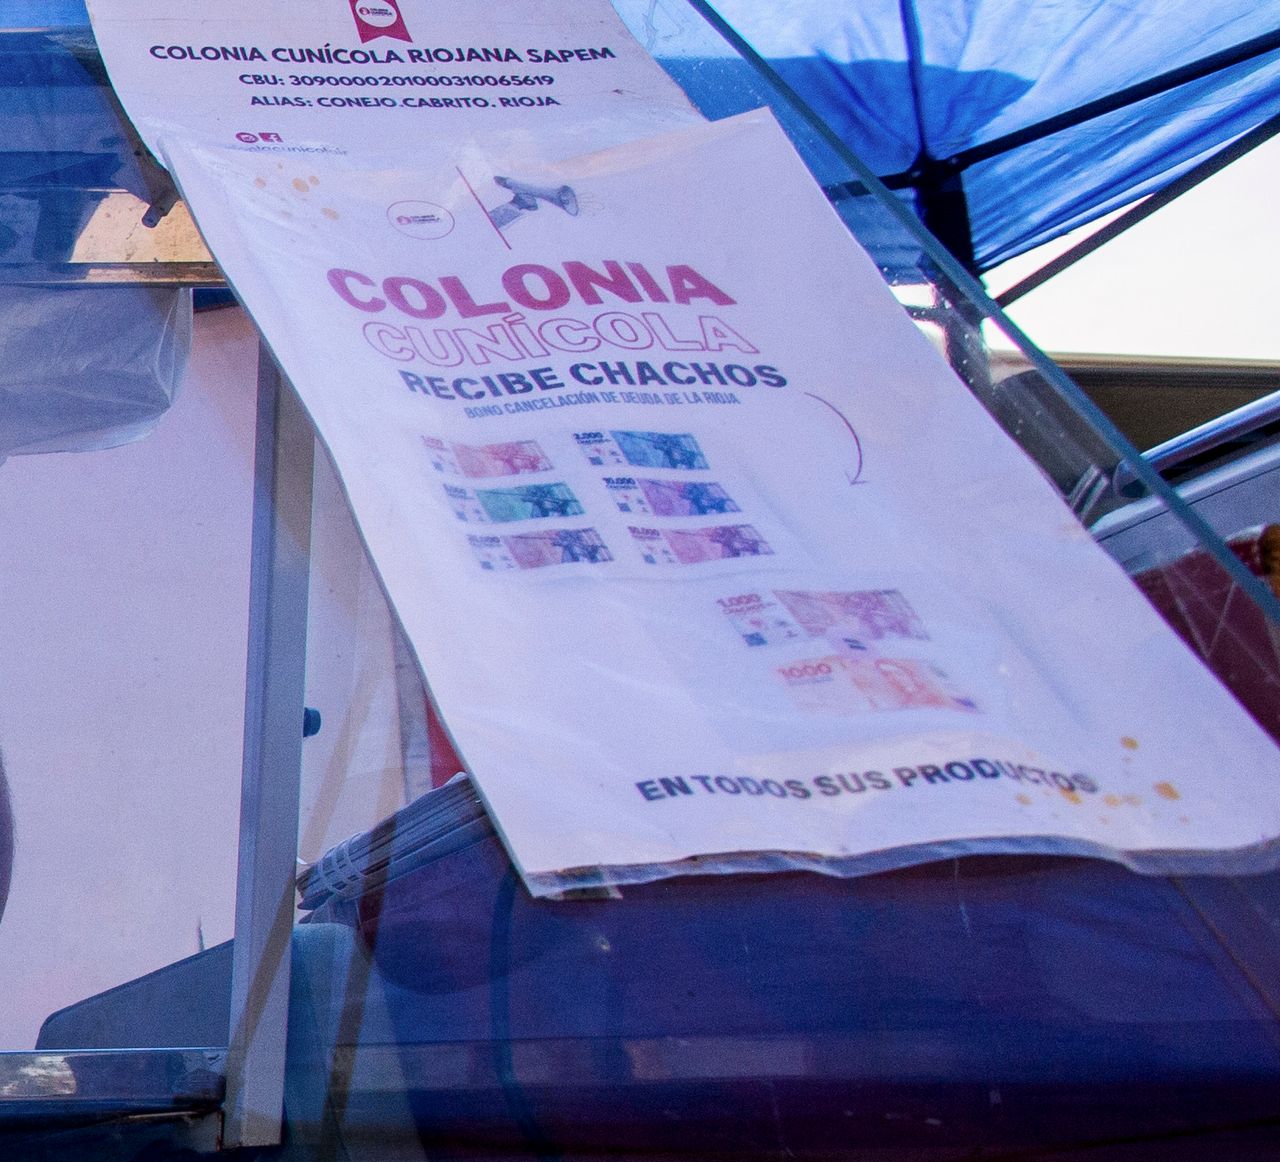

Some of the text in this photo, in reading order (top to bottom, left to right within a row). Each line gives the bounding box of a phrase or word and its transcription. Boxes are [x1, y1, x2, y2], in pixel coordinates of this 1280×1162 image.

[149, 43, 616, 64] COLONIA CUNÍCOLA RIOJANA SAPEM
[239, 73, 555, 87] CBU: 3090000201000310065619
[250, 95, 314, 107] ALIAS:
[498, 96, 561, 108] RIOJA
[326, 260, 737, 319] COLONIA
[362, 311, 760, 367] CUNÍCOLA
[398, 360, 788, 401] RECIBE CHACHOS
[464, 390, 742, 419] BONO CANCELACIÓN DE DEUDA DE LA RIOJA
[635, 758, 1098, 800] EN TODOS SUS PRODUCTOS
